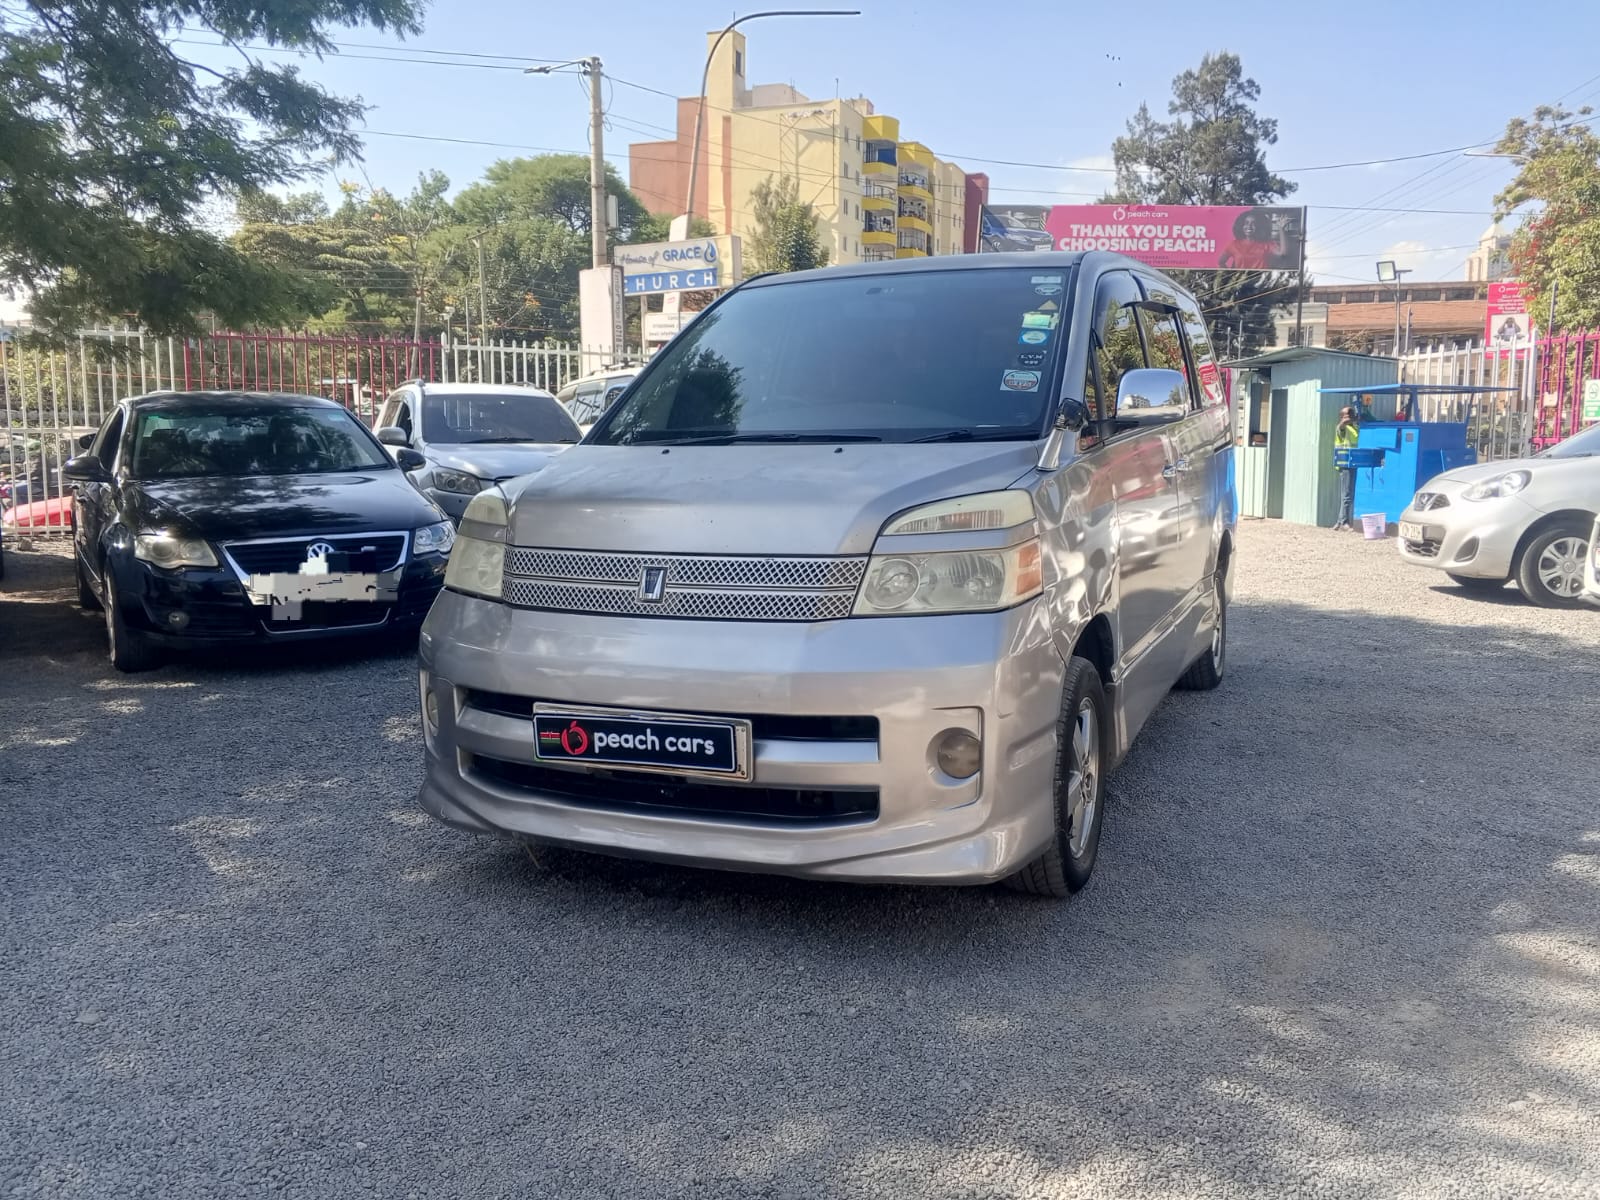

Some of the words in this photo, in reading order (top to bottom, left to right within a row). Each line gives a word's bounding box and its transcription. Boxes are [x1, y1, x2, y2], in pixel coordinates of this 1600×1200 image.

[1128, 209, 1150, 219] peach
[1152, 210, 1168, 218] cars
[1070, 224, 1130, 237] THANK
[1132, 225, 1169, 238] YOU
[1173, 225, 1206, 238] FOR
[1059, 237, 1149, 251] CHOOSING
[1153, 239, 1216, 252] PEACH!
[662, 246, 701, 262] GRACE
[594, 728, 659, 754] peach
[664, 736, 715, 755] cars
